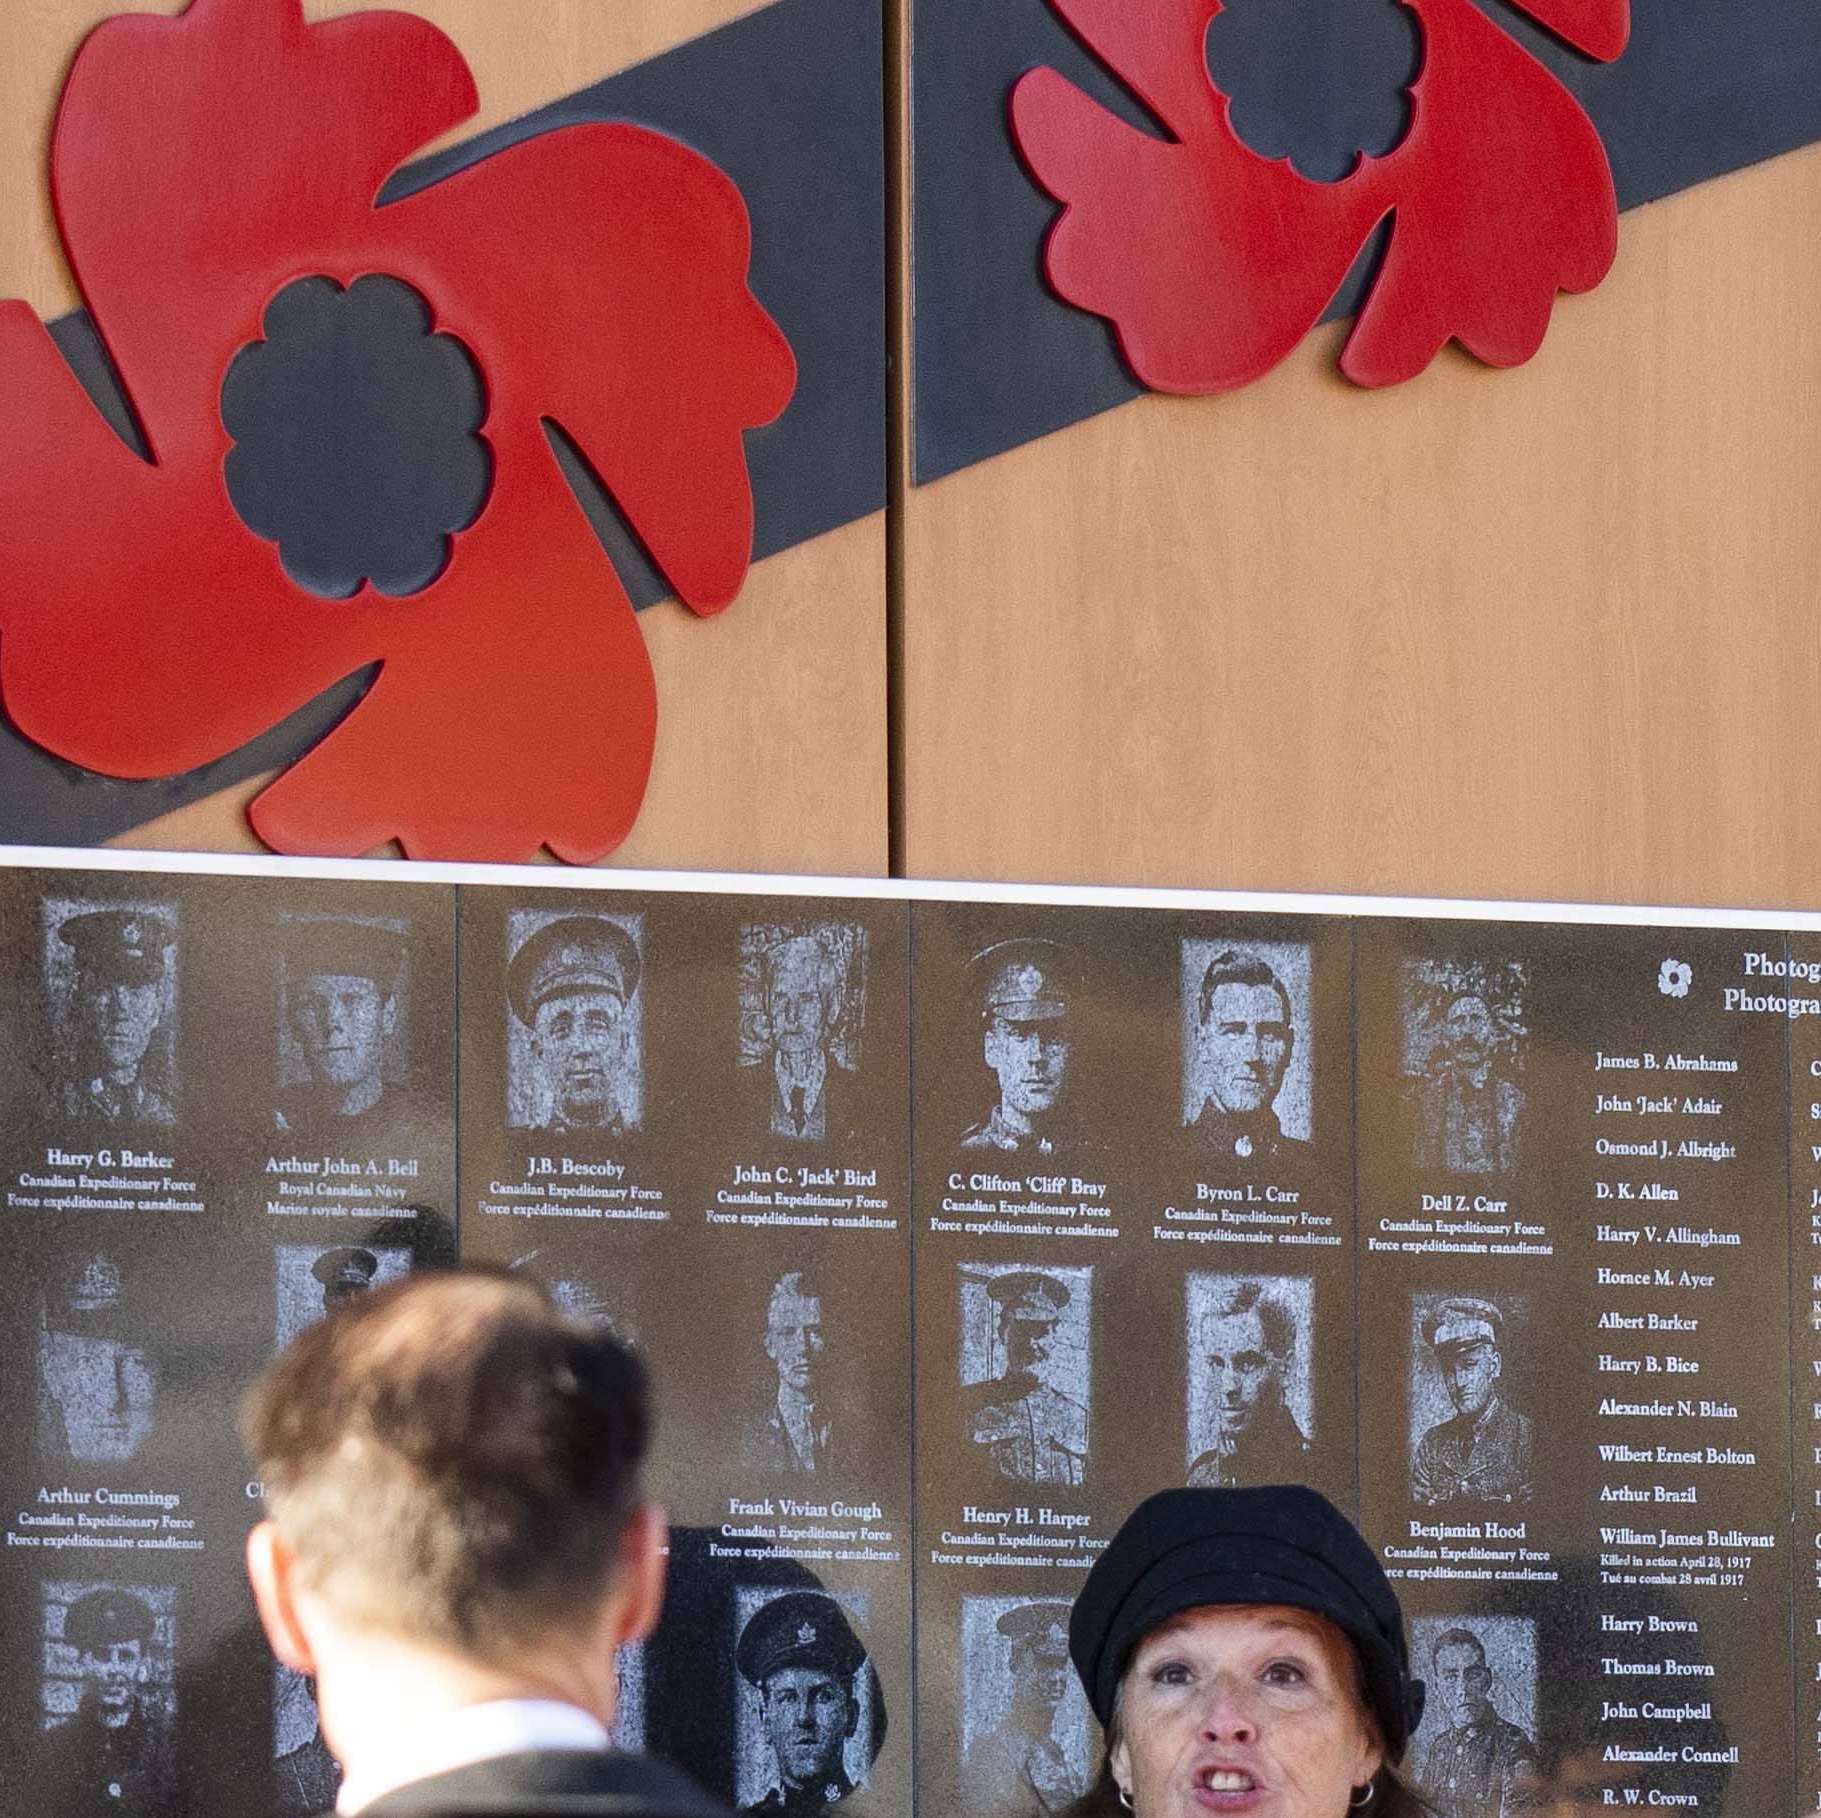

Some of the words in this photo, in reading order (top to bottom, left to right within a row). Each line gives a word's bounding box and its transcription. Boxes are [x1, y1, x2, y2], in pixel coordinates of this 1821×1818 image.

[1595, 1051, 1640, 1071] James
[1643, 1053, 1660, 1069] B.
[1664, 1053, 1738, 1072] Abrahams
[47, 1148, 93, 1169] Harry
[97, 1149, 116, 1166] G.
[120, 1150, 174, 1168] Barker
[265, 1156, 320, 1173] Arthur
[321, 1157, 360, 1177] John
[364, 1159, 383, 1175] A.
[388, 1159, 418, 1176] Bell
[561, 1157, 625, 1180] Bescoby
[279, 1181, 314, 1197] Royal
[316, 1182, 372, 1197] Canadian
[374, 1184, 406, 1200] Navy
[1195, 1183, 1243, 1203] Byron
[1247, 1184, 1261, 1201] L.
[1265, 1185, 1299, 1202] Carr
[266, 1201, 308, 1215] Marine
[311, 1203, 348, 1217] royale
[350, 1204, 417, 1218] canadienne
[1421, 1194, 1452, 1211] Dell
[1455, 1195, 1470, 1211] Z.
[1473, 1195, 1507, 1212] Carr
[1379, 1218, 1433, 1232] Canadian
[1435, 1219, 1511, 1236] Expeditionary
[1514, 1221, 1545, 1235] Force
[1596, 1225, 1640, 1245] Harry
[1643, 1226, 1661, 1242] V.
[1665, 1227, 1741, 1247] Allingham
[1368, 1237, 1399, 1251] Force
[1401, 1238, 1487, 1254] expéditionnaire
[1489, 1240, 1553, 1254] canadienne
[1597, 1267, 1650, 1285] Horace
[1654, 1269, 1674, 1286] M.
[1678, 1270, 1714, 1289] Ayer
[1597, 1311, 1644, 1329] Albert
[1647, 1313, 1698, 1330] Barker
[1598, 1354, 1641, 1375] Harry
[1645, 1355, 1661, 1372] B.
[1665, 1356, 1699, 1373] Bice
[1598, 1398, 1674, 1416] Alexander
[1677, 1400, 1695, 1416] N.
[1699, 1401, 1738, 1417] Blain
[1598, 1444, 1653, 1462] Wilbert
[1656, 1446, 1702, 1463] Ernest
[1706, 1447, 1755, 1464] Bolton
[37, 1486, 91, 1504] Arthur
[94, 1487, 179, 1510] Cummings
[1599, 1484, 1650, 1501] Arthur
[1653, 1485, 1697, 1503] Brazil
[729, 1498, 774, 1515] Frank
[778, 1499, 827, 1517] Vivian
[831, 1500, 882, 1521] Gough
[963, 1506, 1011, 1527] Henry
[1015, 1507, 1033, 1524] H.
[1038, 1508, 1091, 1529] Harper
[1409, 1521, 1481, 1541] Benjamin
[1484, 1521, 1525, 1538] Hood
[1599, 1527, 1656, 1545] William
[1658, 1529, 1703, 1548] James
[1707, 1530, 1775, 1547] Bullivant
[1601, 1614, 1644, 1635] Harry
[1648, 1615, 1698, 1632] Brown
[1601, 1658, 1661, 1675] Thomas
[1664, 1659, 1714, 1676] Brown
[1601, 1701, 1638, 1721] John
[1641, 1702, 1711, 1722] Campbell
[1602, 1744, 1678, 1762] Alexander
[1681, 1746, 1739, 1763] Connell
